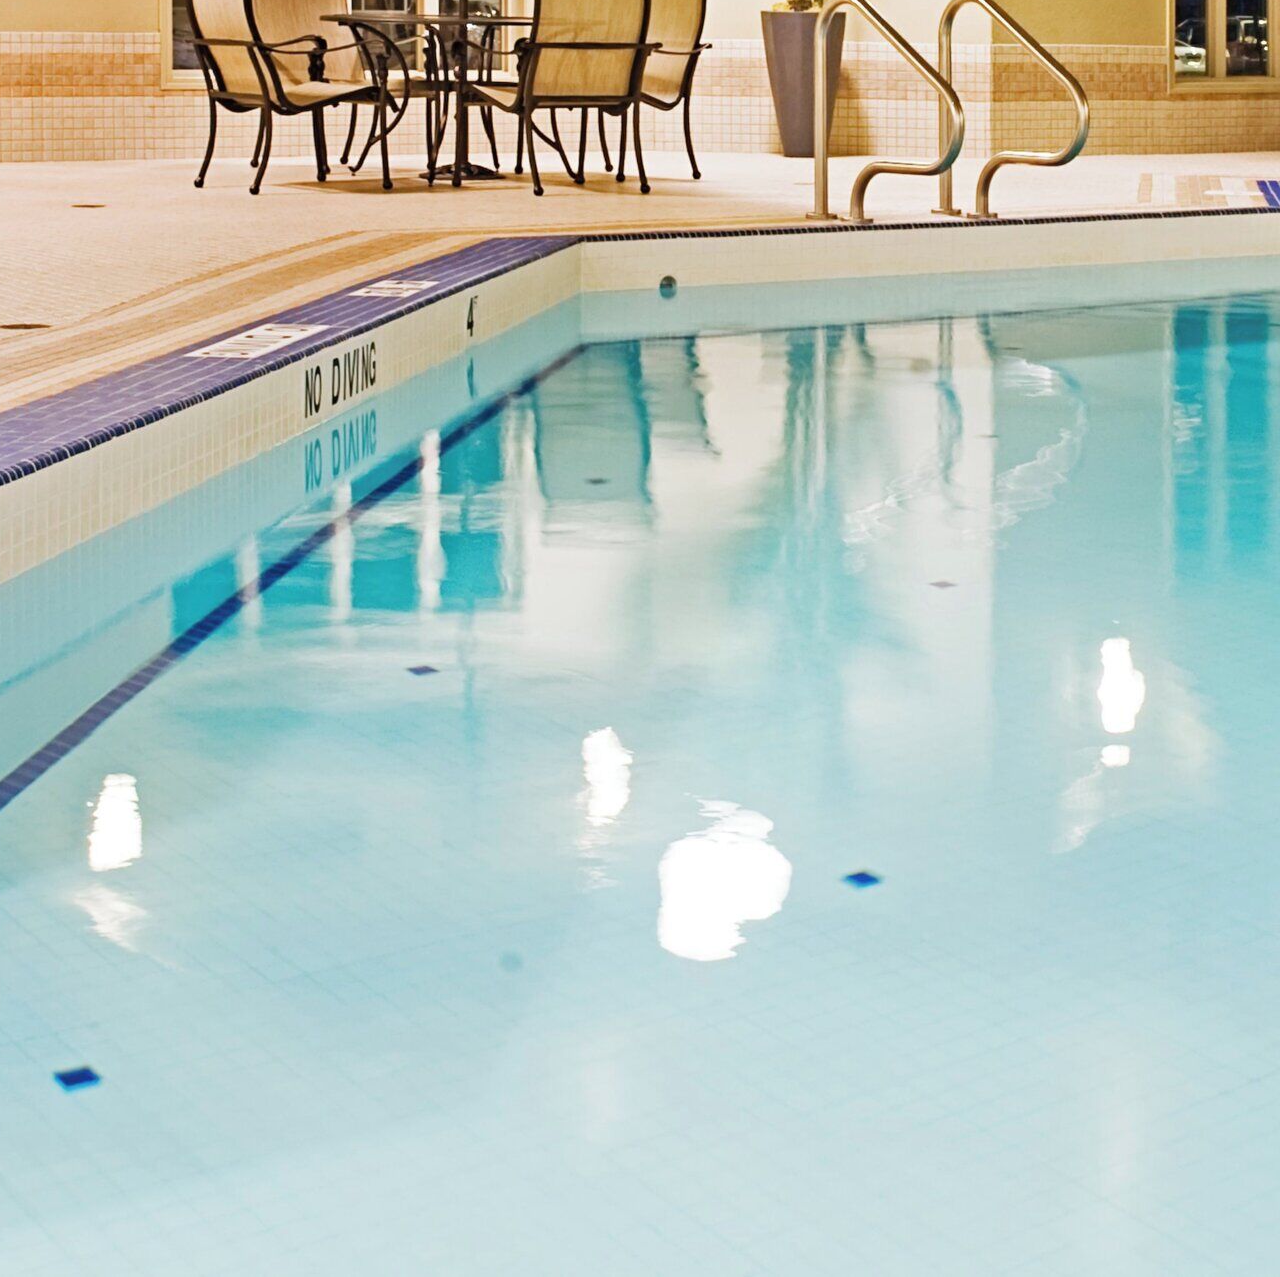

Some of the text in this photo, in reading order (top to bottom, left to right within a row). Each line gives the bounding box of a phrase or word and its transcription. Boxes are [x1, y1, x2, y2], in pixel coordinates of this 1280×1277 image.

[466, 297, 474, 337] 4
[304, 365, 322, 419] NO
[331, 341, 376, 405] DIVING
